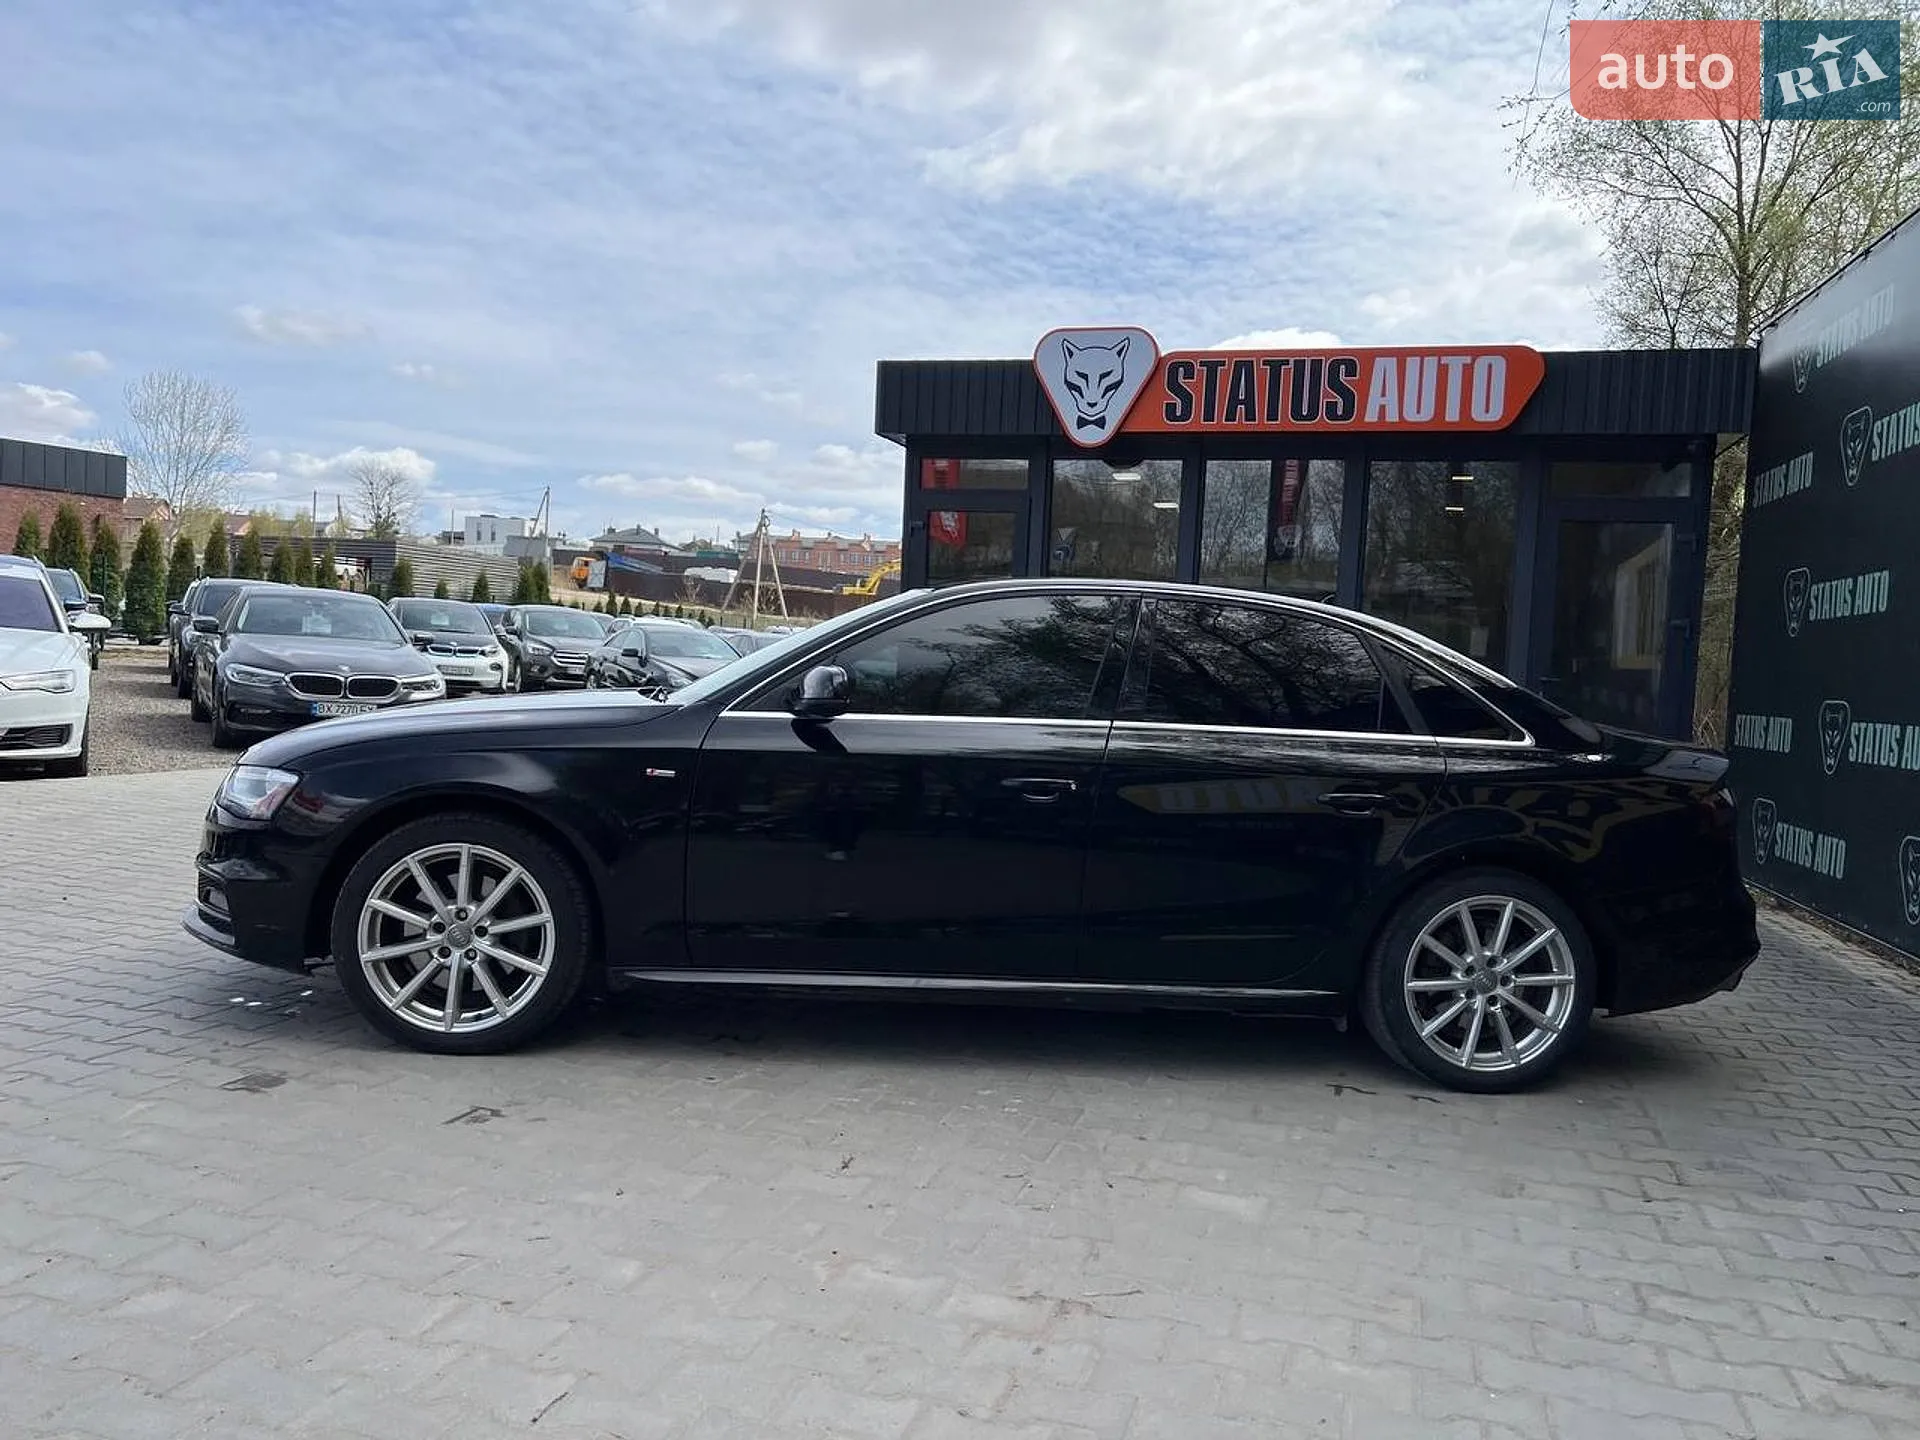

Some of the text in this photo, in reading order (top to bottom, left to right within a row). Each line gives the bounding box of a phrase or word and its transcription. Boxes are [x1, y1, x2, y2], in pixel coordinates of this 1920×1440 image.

[1162, 354, 1508, 425] STATUS AUTO
[1786, 451, 1813, 495] AUTO
[1809, 570, 1889, 621] STATUS AUTO
[1734, 714, 1792, 753] STATUS AUTO
[1848, 722, 1901, 768] STATUS
[1774, 821, 1847, 880] STATUS AUTO
